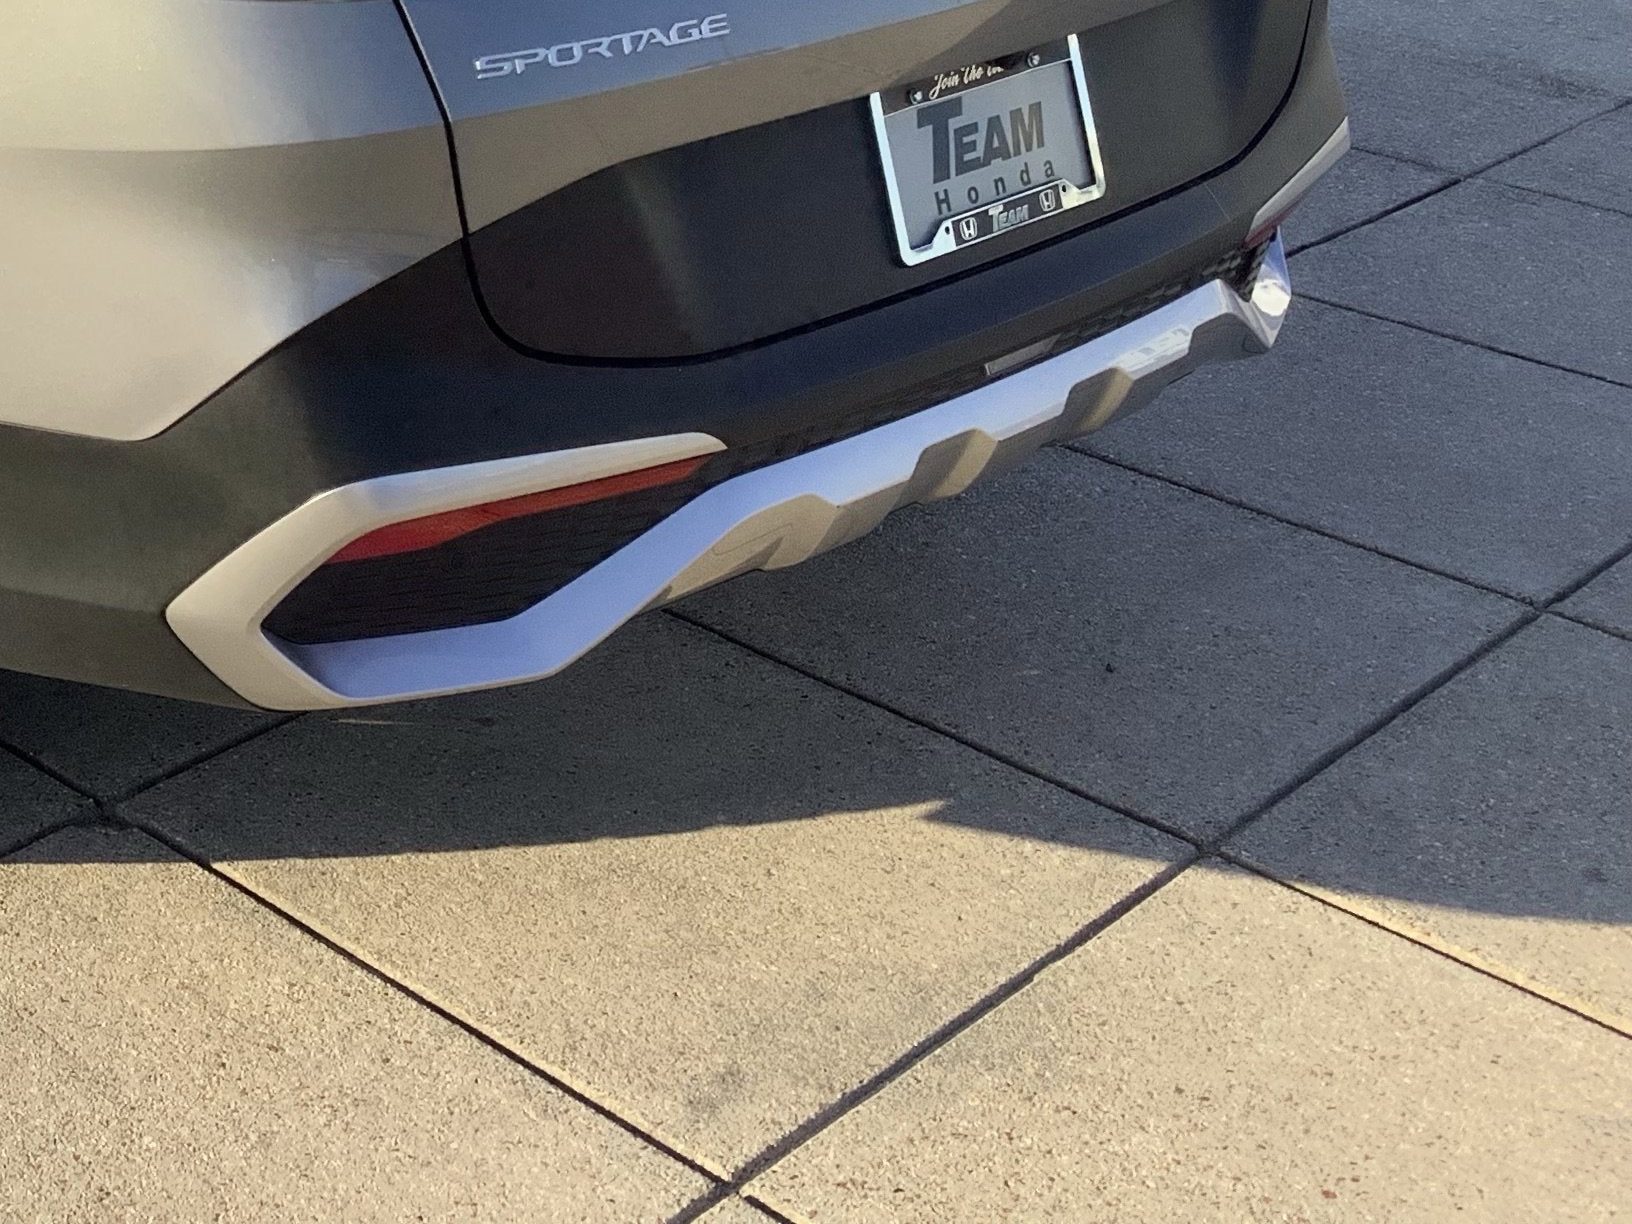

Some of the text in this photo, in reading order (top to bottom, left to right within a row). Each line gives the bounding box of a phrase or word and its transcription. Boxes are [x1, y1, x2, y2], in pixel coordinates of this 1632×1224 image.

[475, 14, 730, 79] SPORTAGE
[929, 71, 959, 100] Join
[917, 96, 1045, 184] TEAM
[934, 160, 1055, 215] Honda
[988, 204, 1030, 232] TEAM
